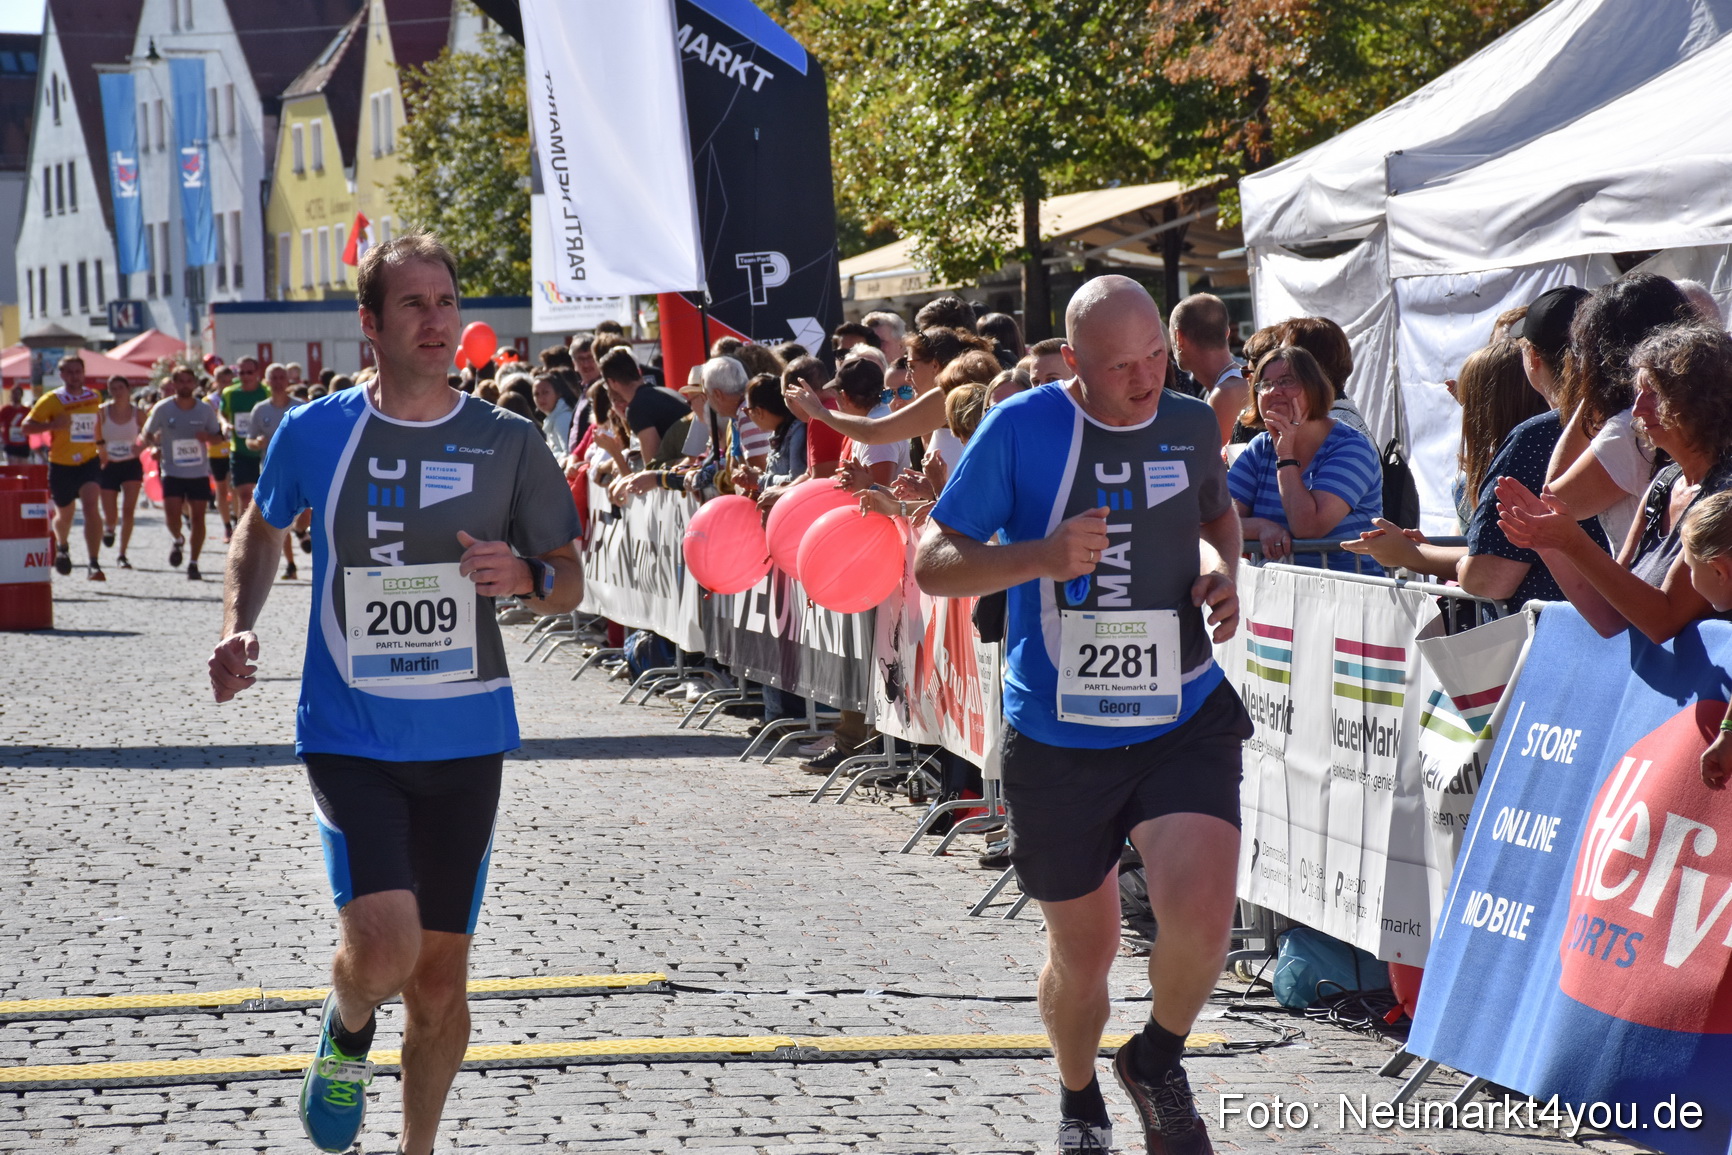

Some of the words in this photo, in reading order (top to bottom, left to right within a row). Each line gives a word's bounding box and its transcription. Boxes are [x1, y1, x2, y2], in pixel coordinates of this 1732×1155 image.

[368, 457, 406, 567] ATEC
[383, 576, 439, 590] BOCK
[366, 597, 457, 636] 2009
[1095, 622, 1147, 634] BOCK
[376, 641, 403, 649] PARTL
[405, 640, 441, 648] Neumarkt
[1077, 644, 1158, 678] 2281
[390, 656, 439, 673] Martin
[1099, 699, 1141, 716] Georg
[1521, 722, 1582, 764] STORE
[1492, 806, 1561, 852] ONLINE
[1576, 756, 1732, 969] Herv
[1461, 890, 1535, 941] MOBILE
